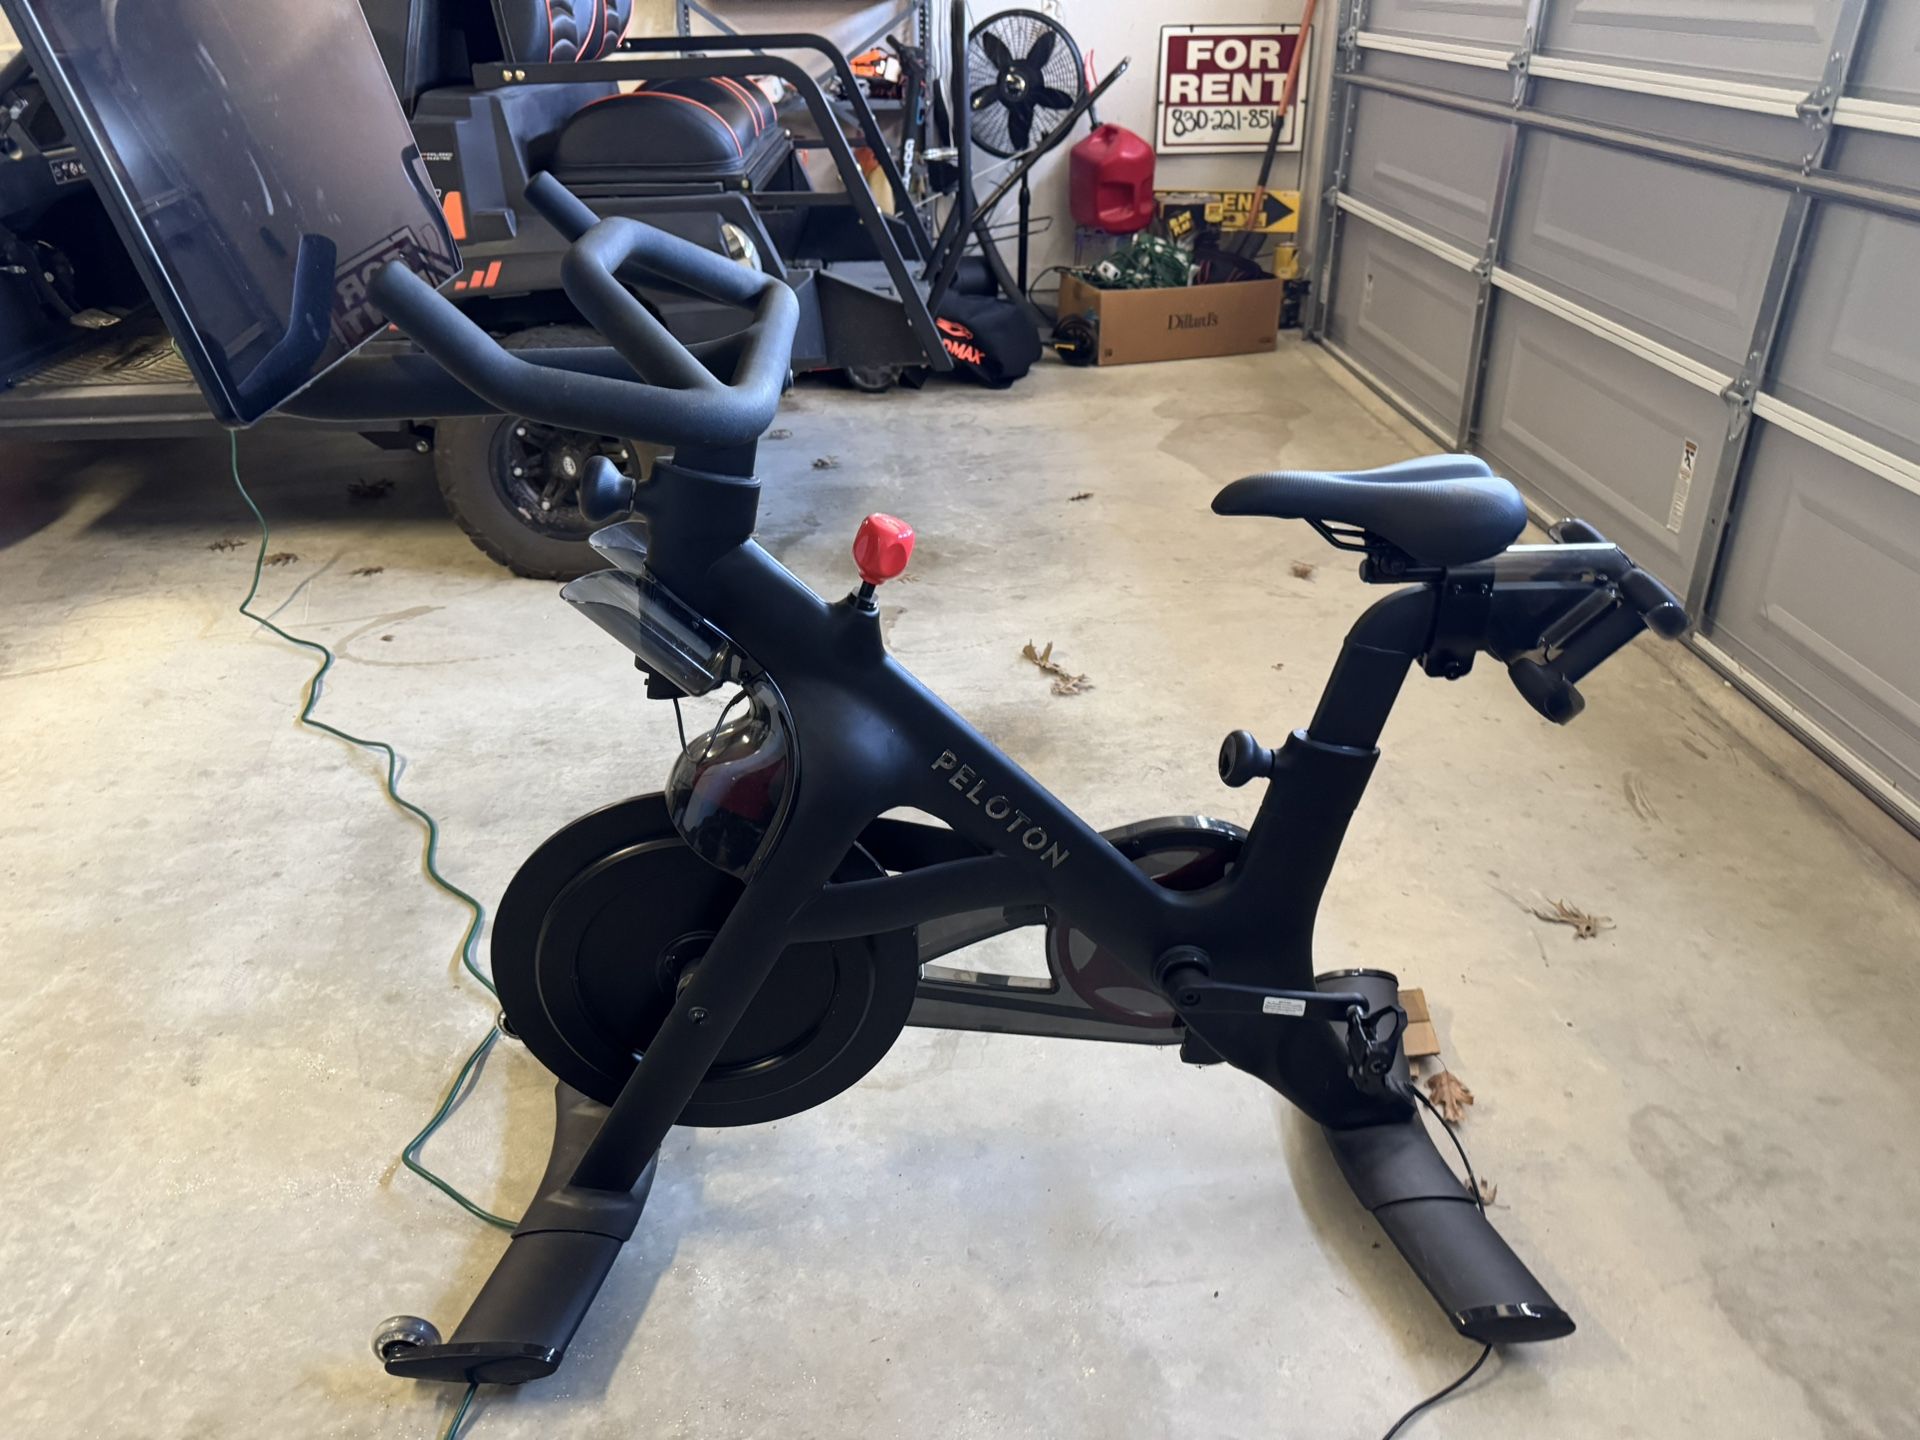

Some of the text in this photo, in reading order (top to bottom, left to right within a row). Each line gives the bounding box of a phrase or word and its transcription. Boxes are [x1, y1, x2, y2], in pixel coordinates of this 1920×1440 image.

[1186, 39, 1281, 70] FOR
[1169, 73, 1288, 103] RENT
[1171, 108, 1282, 137] 830-221-851
[931, 749, 1070, 868] PELOTON
